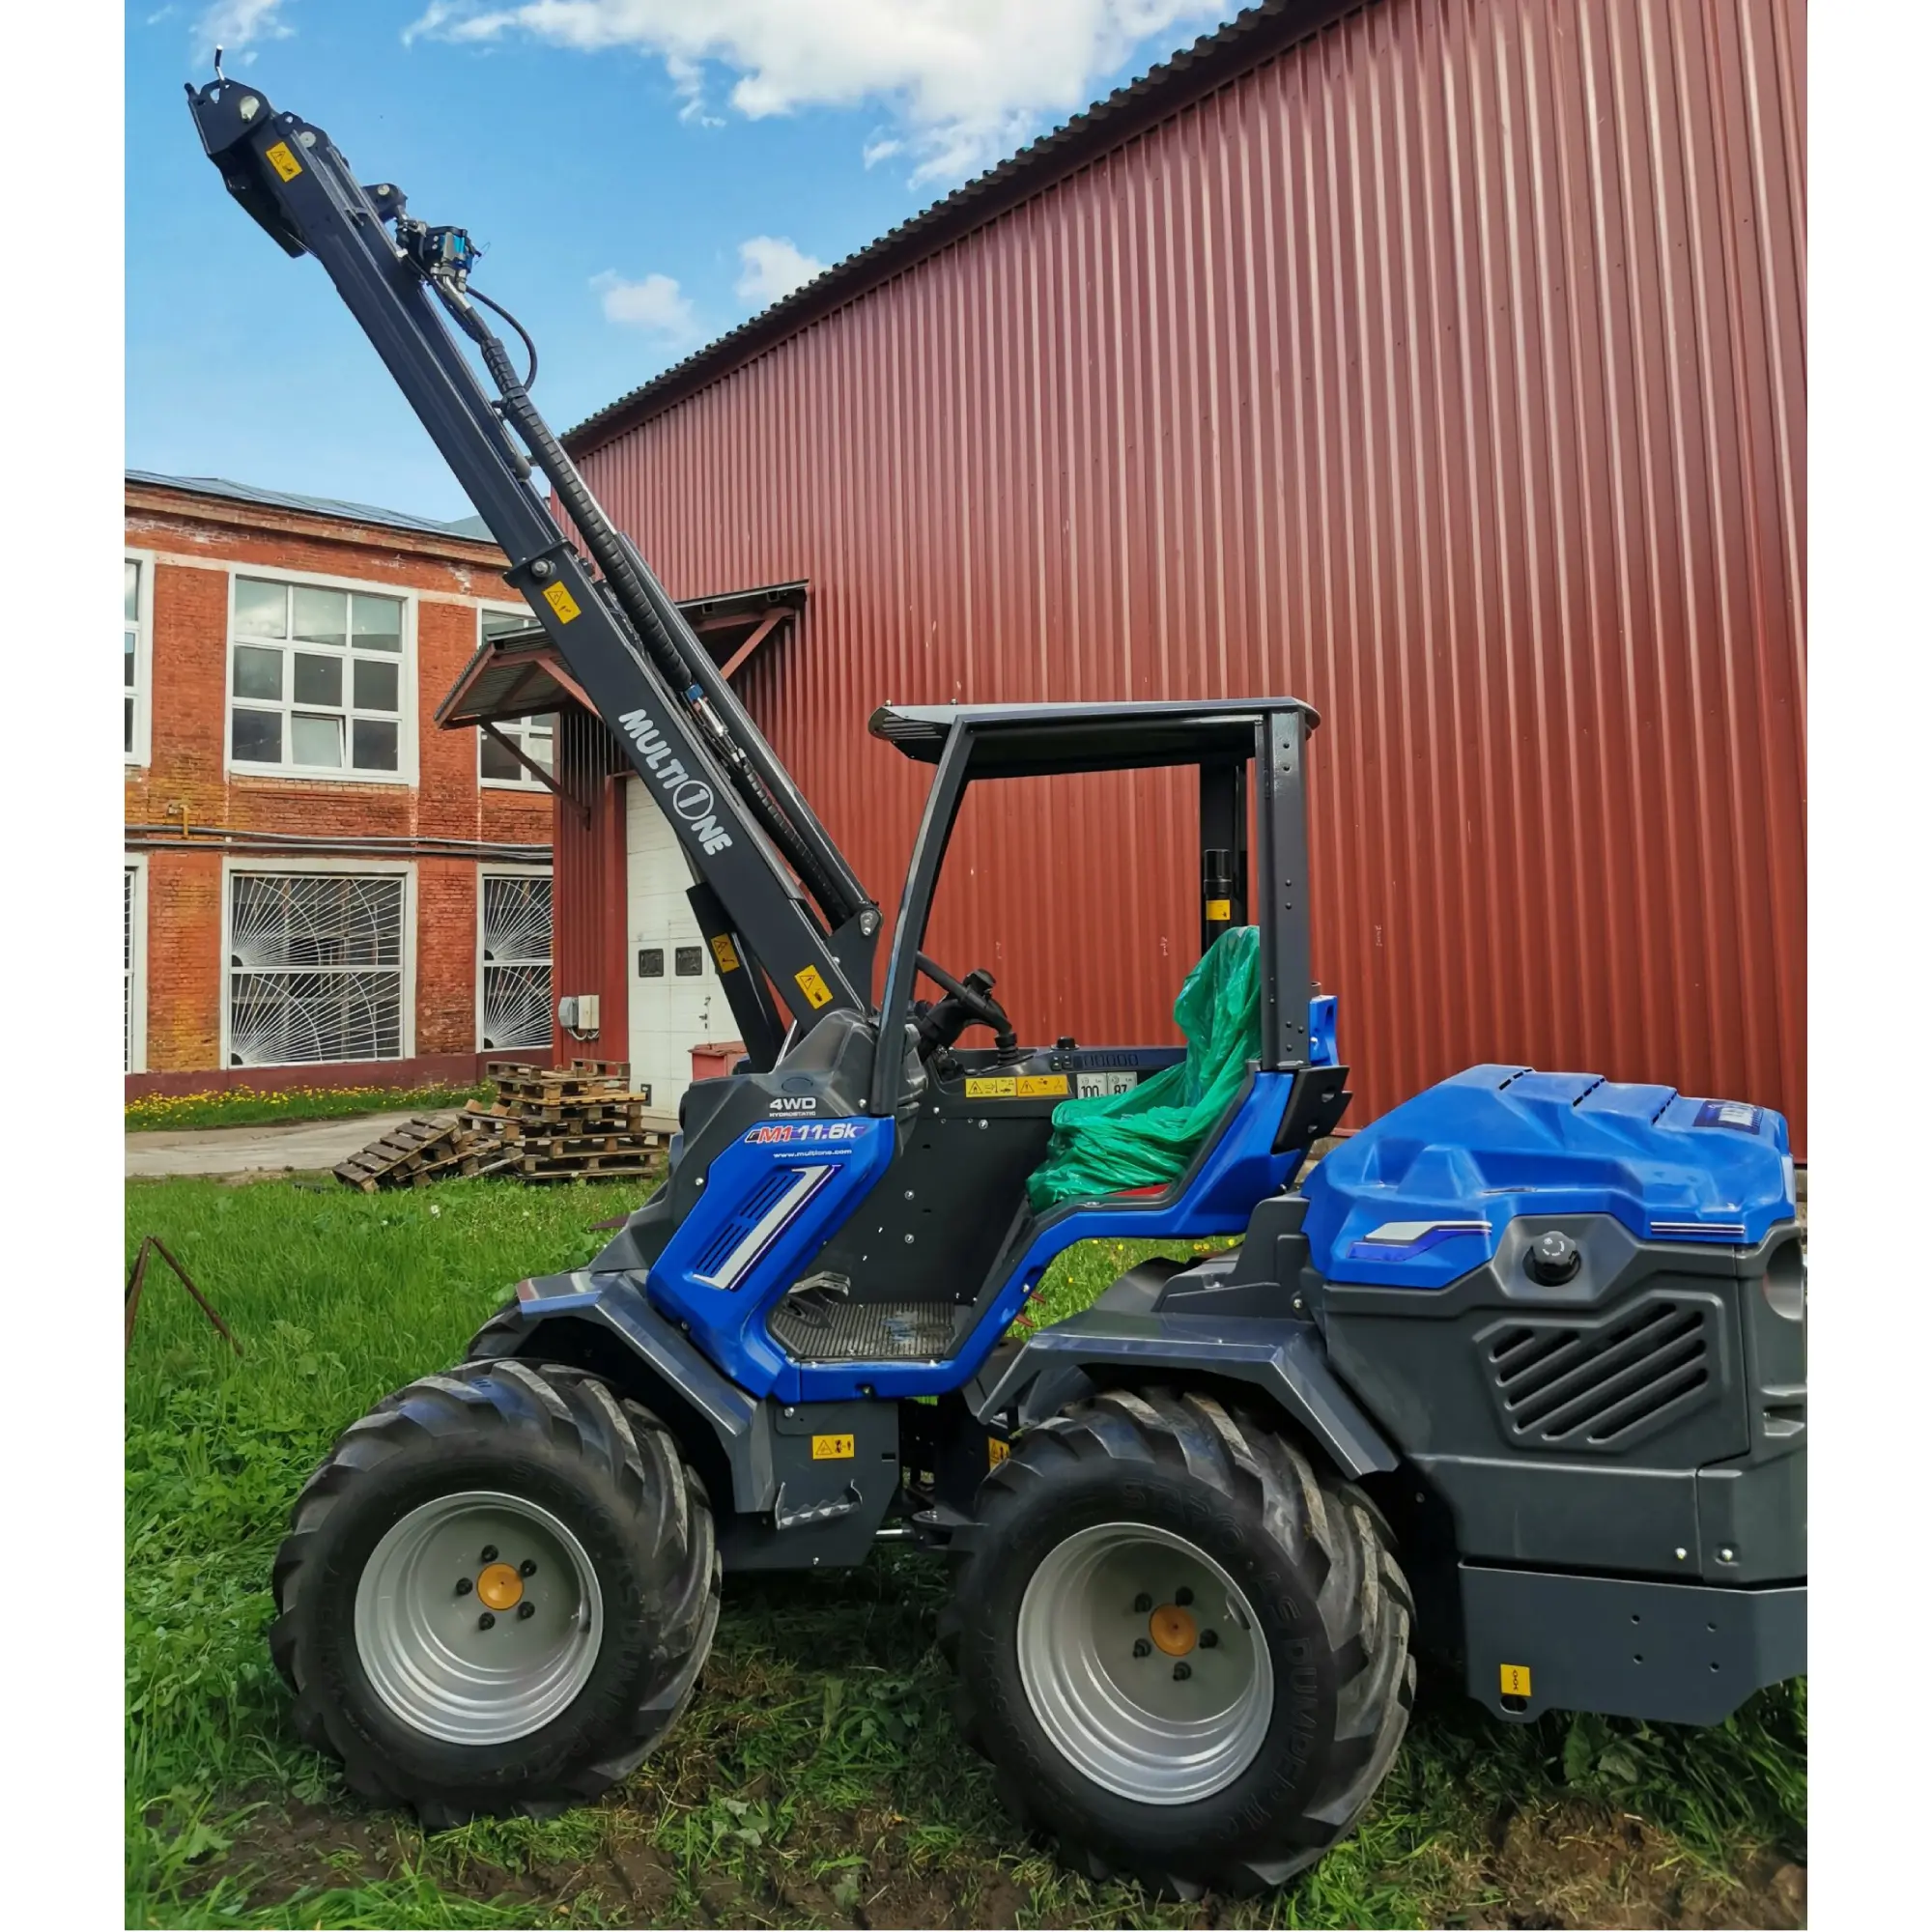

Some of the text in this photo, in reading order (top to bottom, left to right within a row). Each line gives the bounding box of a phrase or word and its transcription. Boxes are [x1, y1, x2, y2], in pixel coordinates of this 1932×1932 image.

[770, 1097, 816, 1110] 4WD
[797, 1123, 857, 1141] 11.6k
[773, 1149, 852, 1158] www.multione.com
